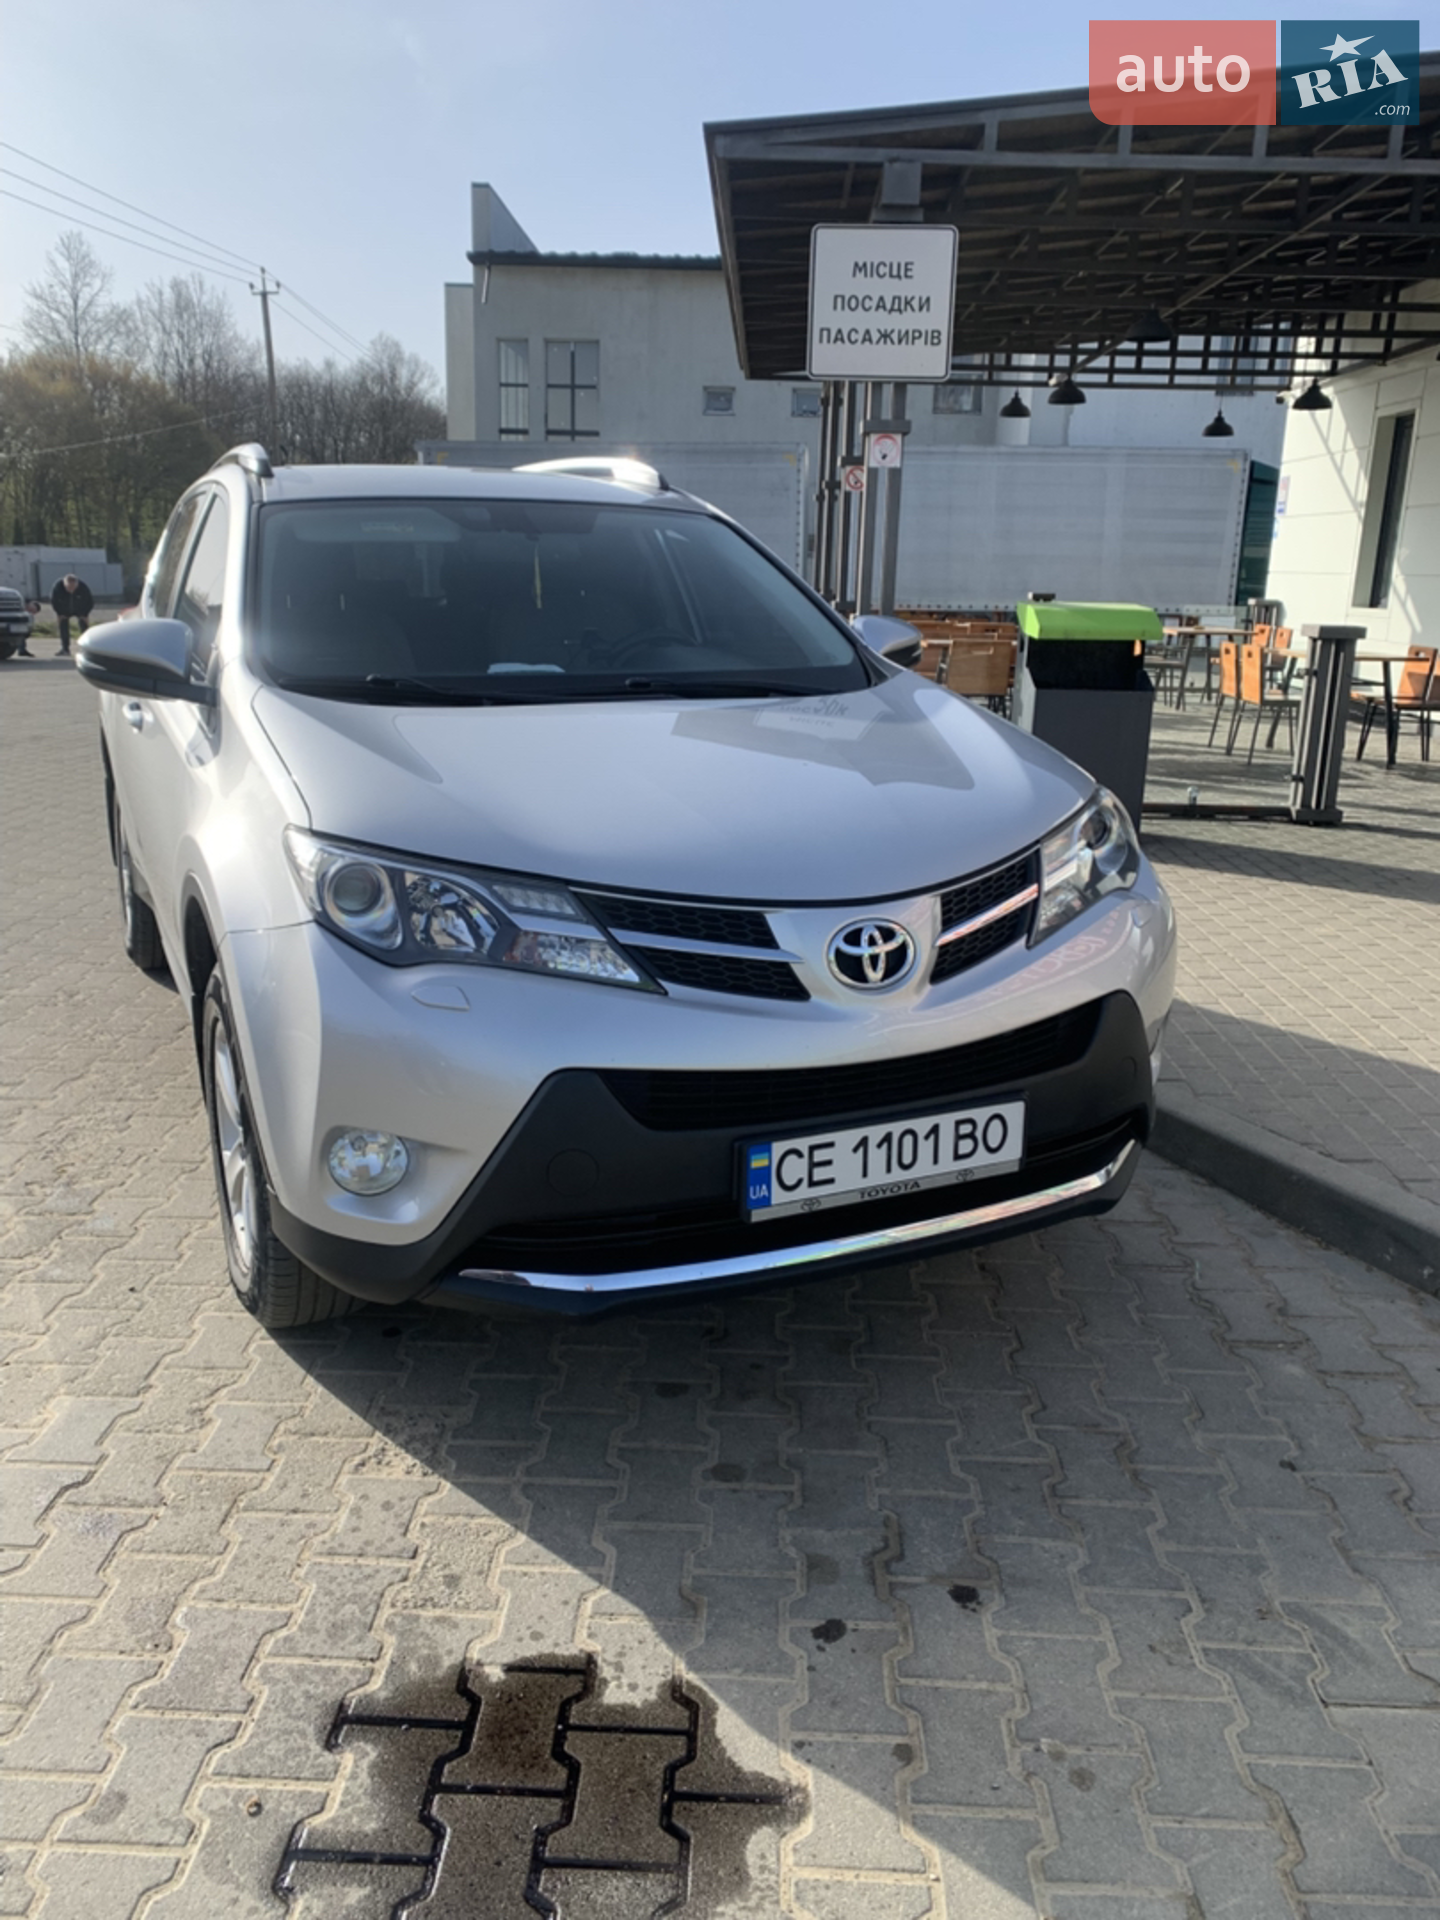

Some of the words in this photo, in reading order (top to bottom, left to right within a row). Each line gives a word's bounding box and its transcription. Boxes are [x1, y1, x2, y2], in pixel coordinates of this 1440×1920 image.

[852, 261, 914, 281] МІСЦЕ
[833, 294, 931, 315] ПОСАДКИ
[818, 327, 942, 347] ПАСАЖИРІВ
[775, 1140, 836, 1192] CE
[851, 1122, 940, 1179] 1101
[952, 1112, 1008, 1162] BO
[750, 1183, 769, 1200] UA
[859, 1180, 921, 1200] TOYOTA
